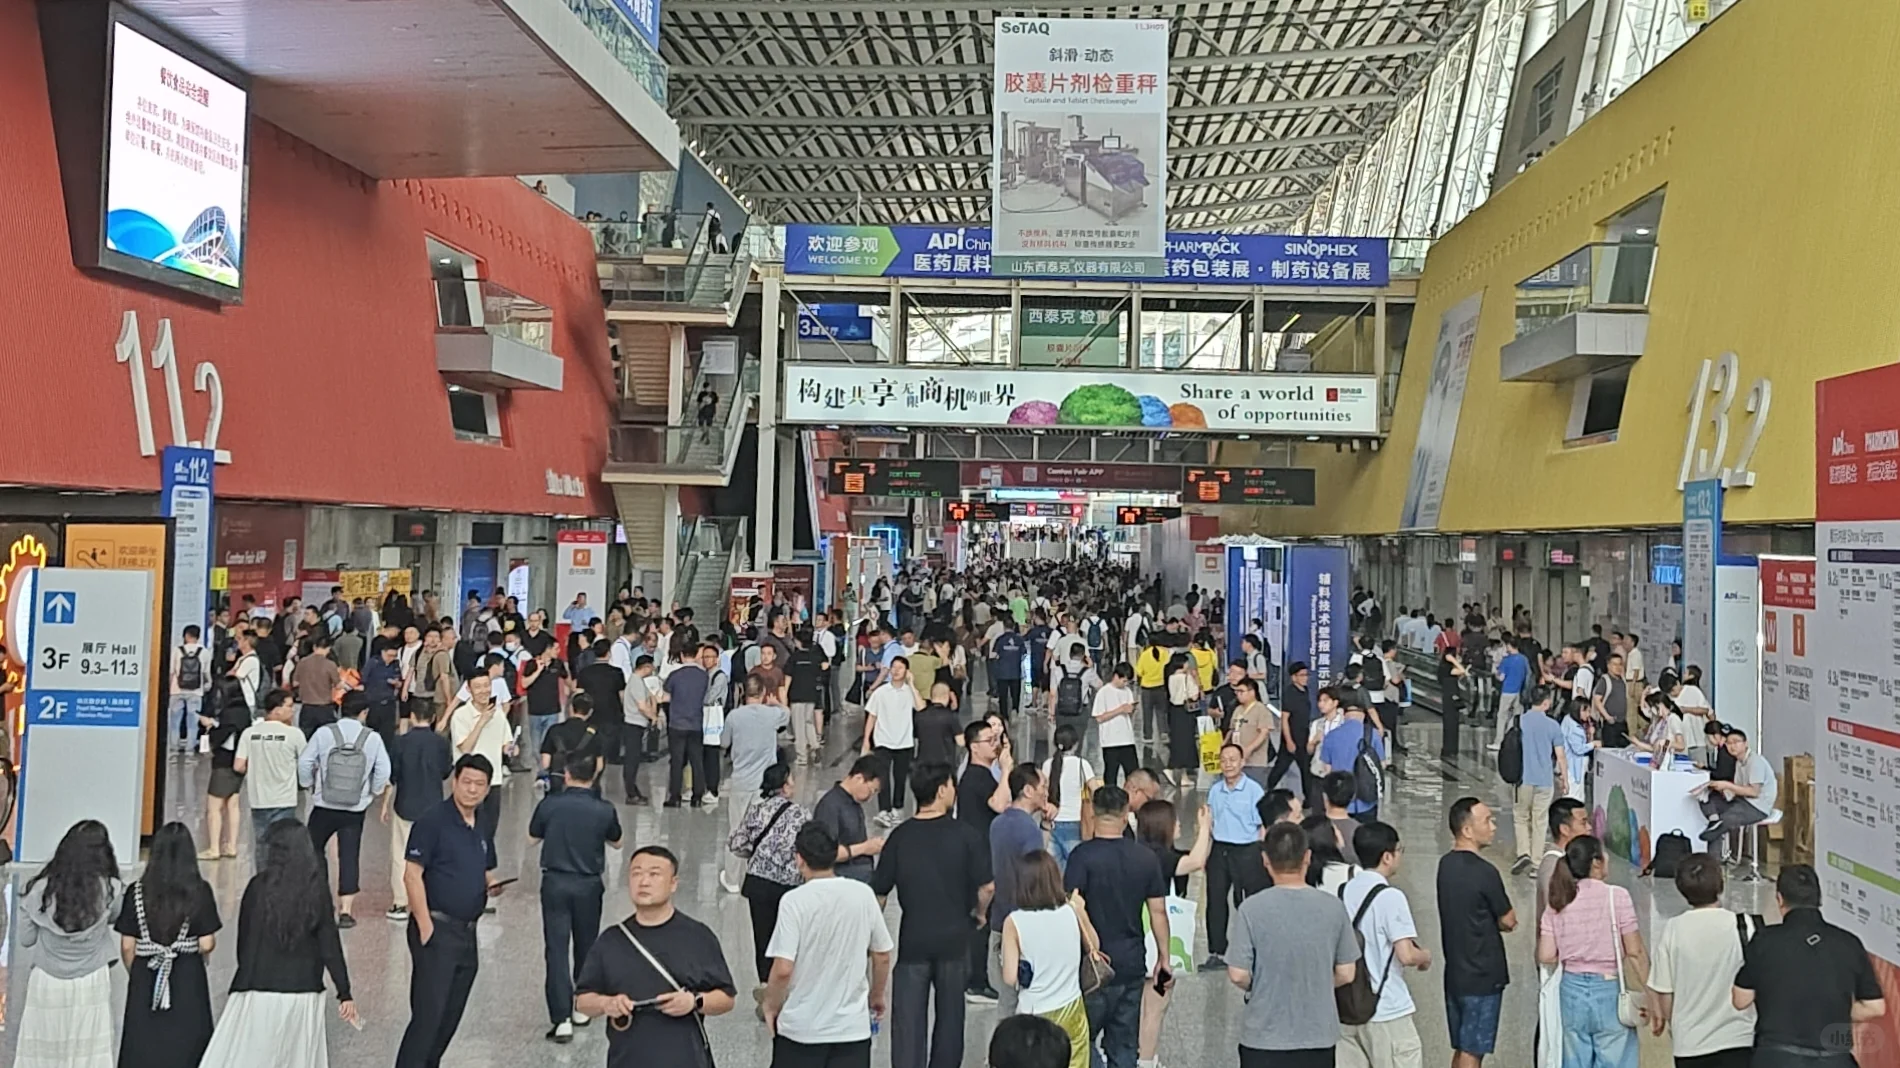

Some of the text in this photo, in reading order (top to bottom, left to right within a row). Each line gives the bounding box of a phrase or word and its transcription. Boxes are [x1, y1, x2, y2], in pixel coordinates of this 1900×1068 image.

[1001, 22, 1050, 36] SeTAQ
[1004, 72, 1158, 94] 胶囊片剂检重秤
[1052, 97, 1066, 105] and
[808, 235, 879, 253] 欢迎参观
[1285, 241, 1359, 257] SINOPHEX
[808, 255, 878, 266] WELCOME TO
[913, 253, 992, 273] 医药原料
[1028, 308, 1075, 324] 西泰克
[797, 376, 1016, 412] 构建共享无限商机的世界
[1180, 383, 1314, 401] Share a world
[1218, 404, 1352, 424] of opportunities
[82, 642, 136, 655] 展厅 Hall
[42, 647, 71, 670] 3F
[37, 695, 68, 720] 2F
